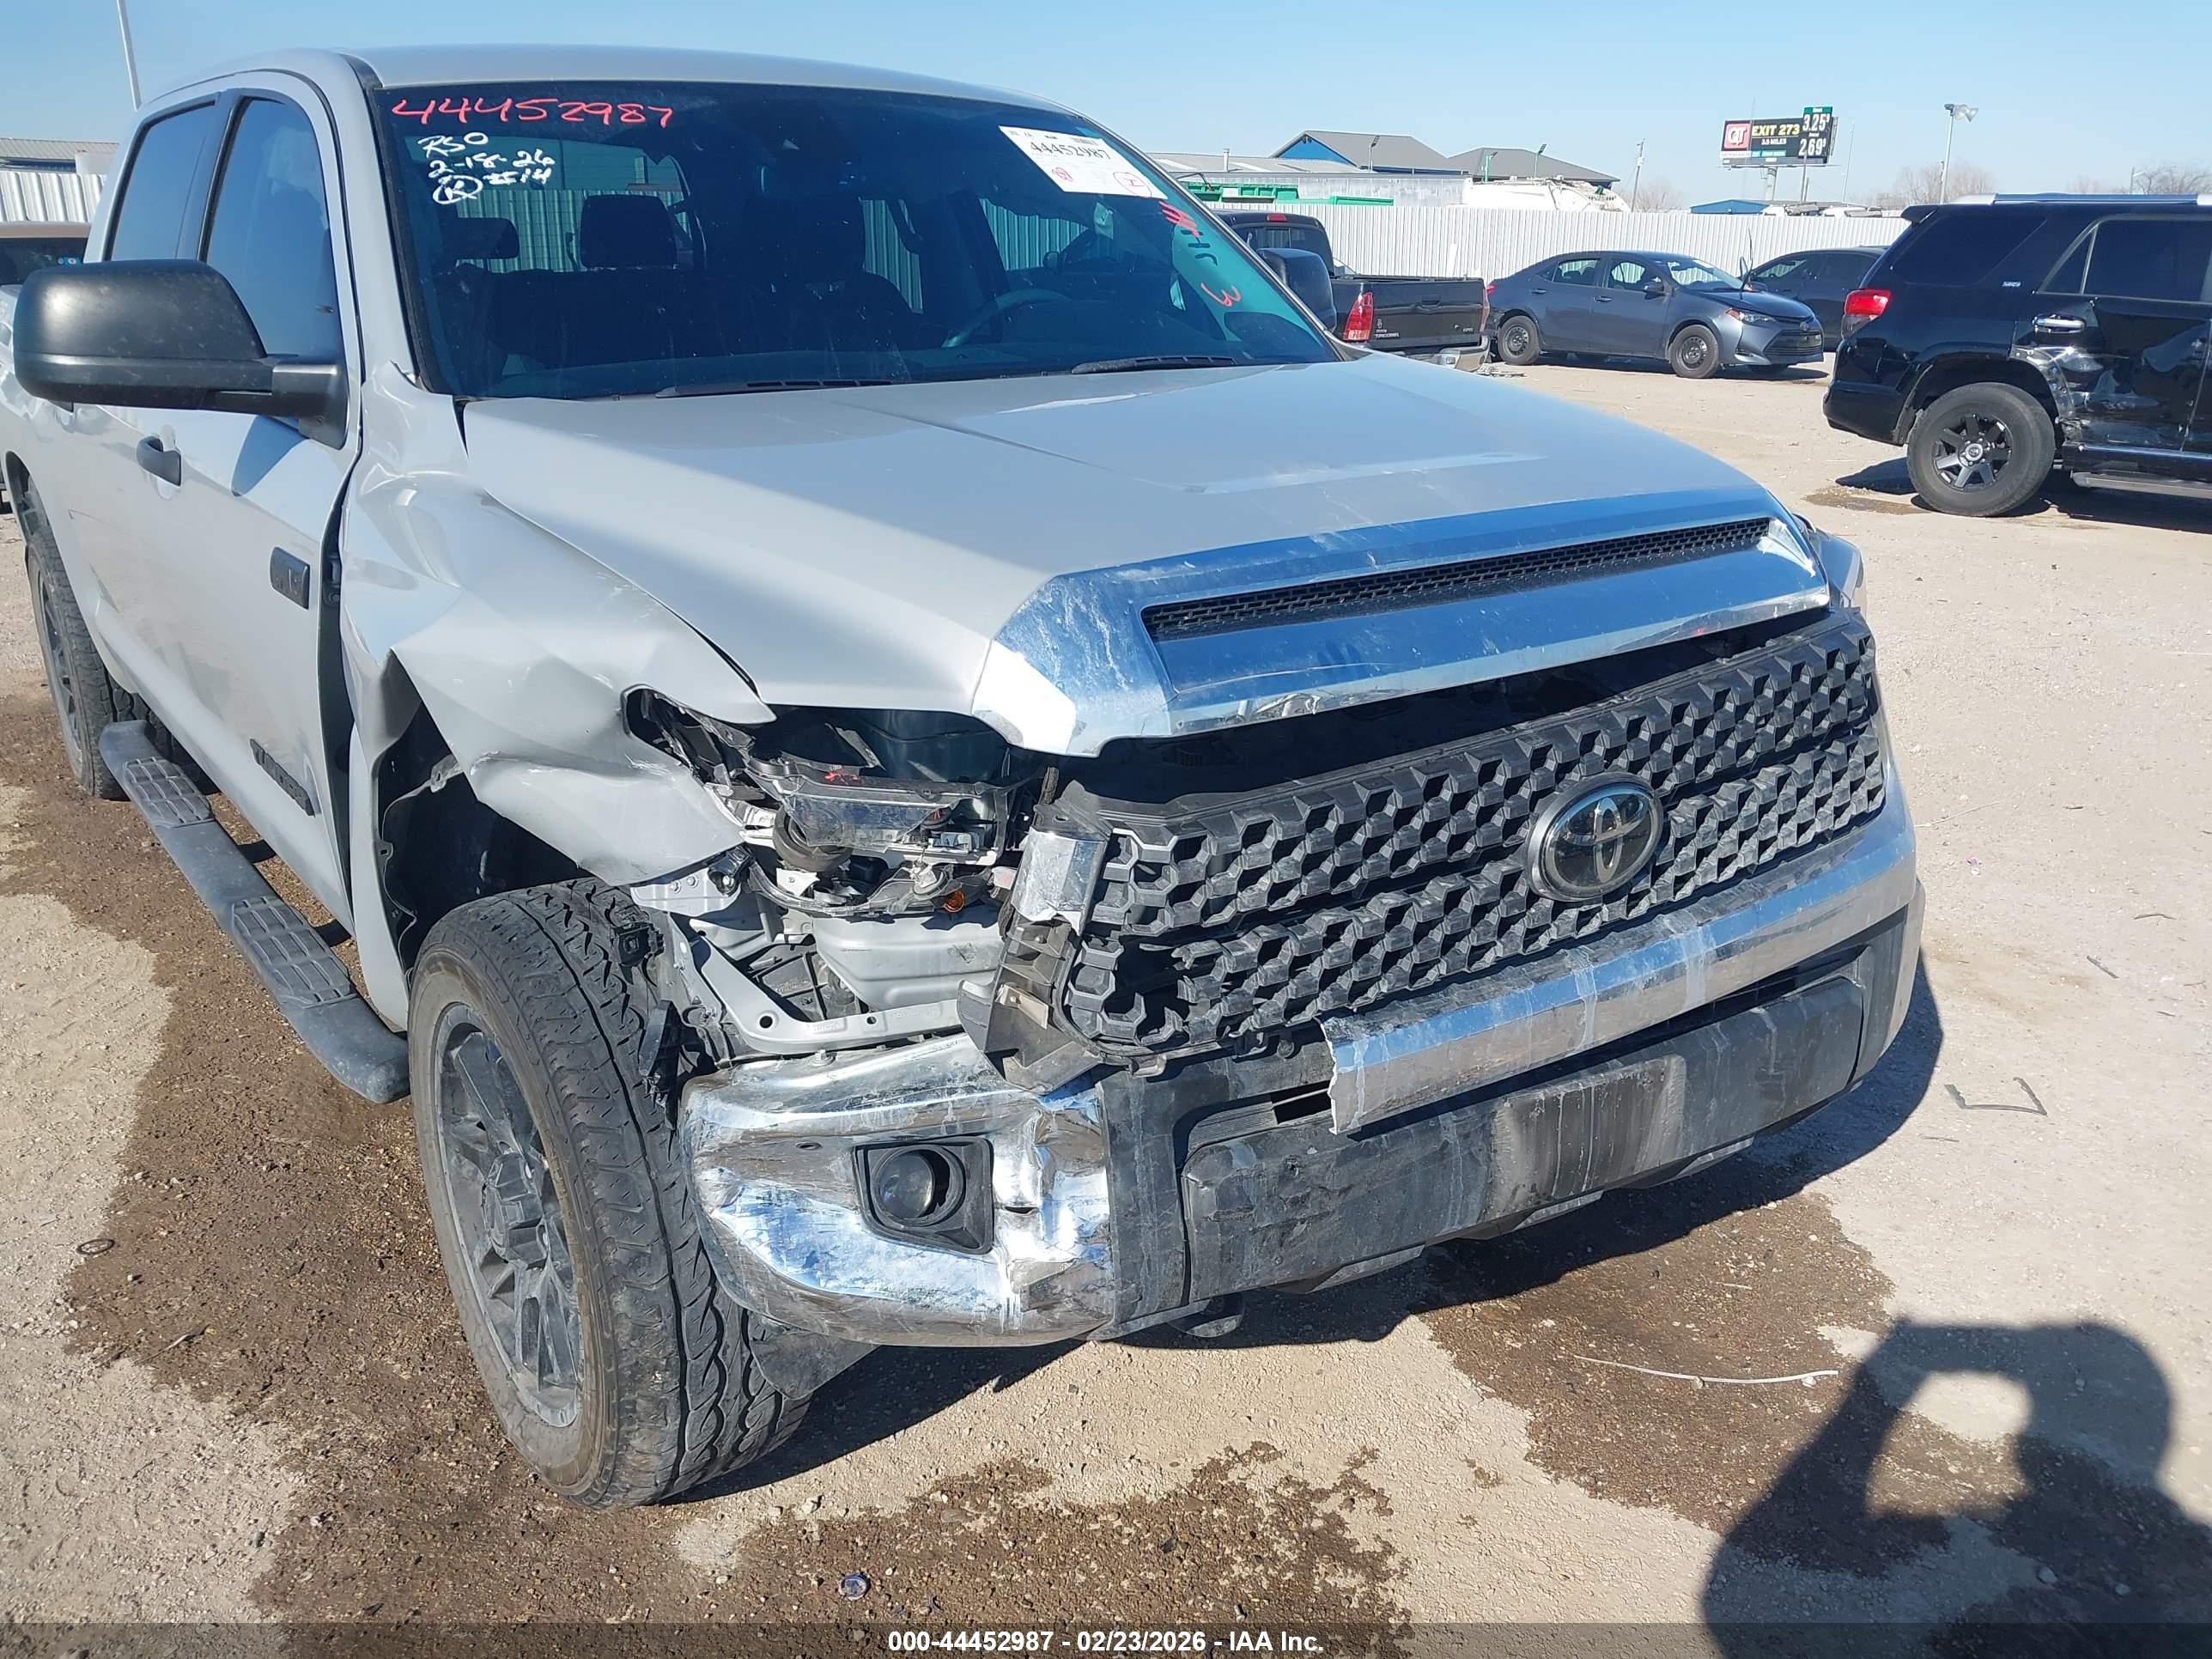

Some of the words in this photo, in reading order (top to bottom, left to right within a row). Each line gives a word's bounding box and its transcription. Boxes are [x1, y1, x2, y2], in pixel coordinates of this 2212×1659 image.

[392, 97, 673, 128] 44452987
[1728, 127, 1747, 145] QT
[1752, 125, 1777, 136] EXIT
[1778, 124, 1800, 135] 273
[1030, 141, 1112, 160] 44452987
